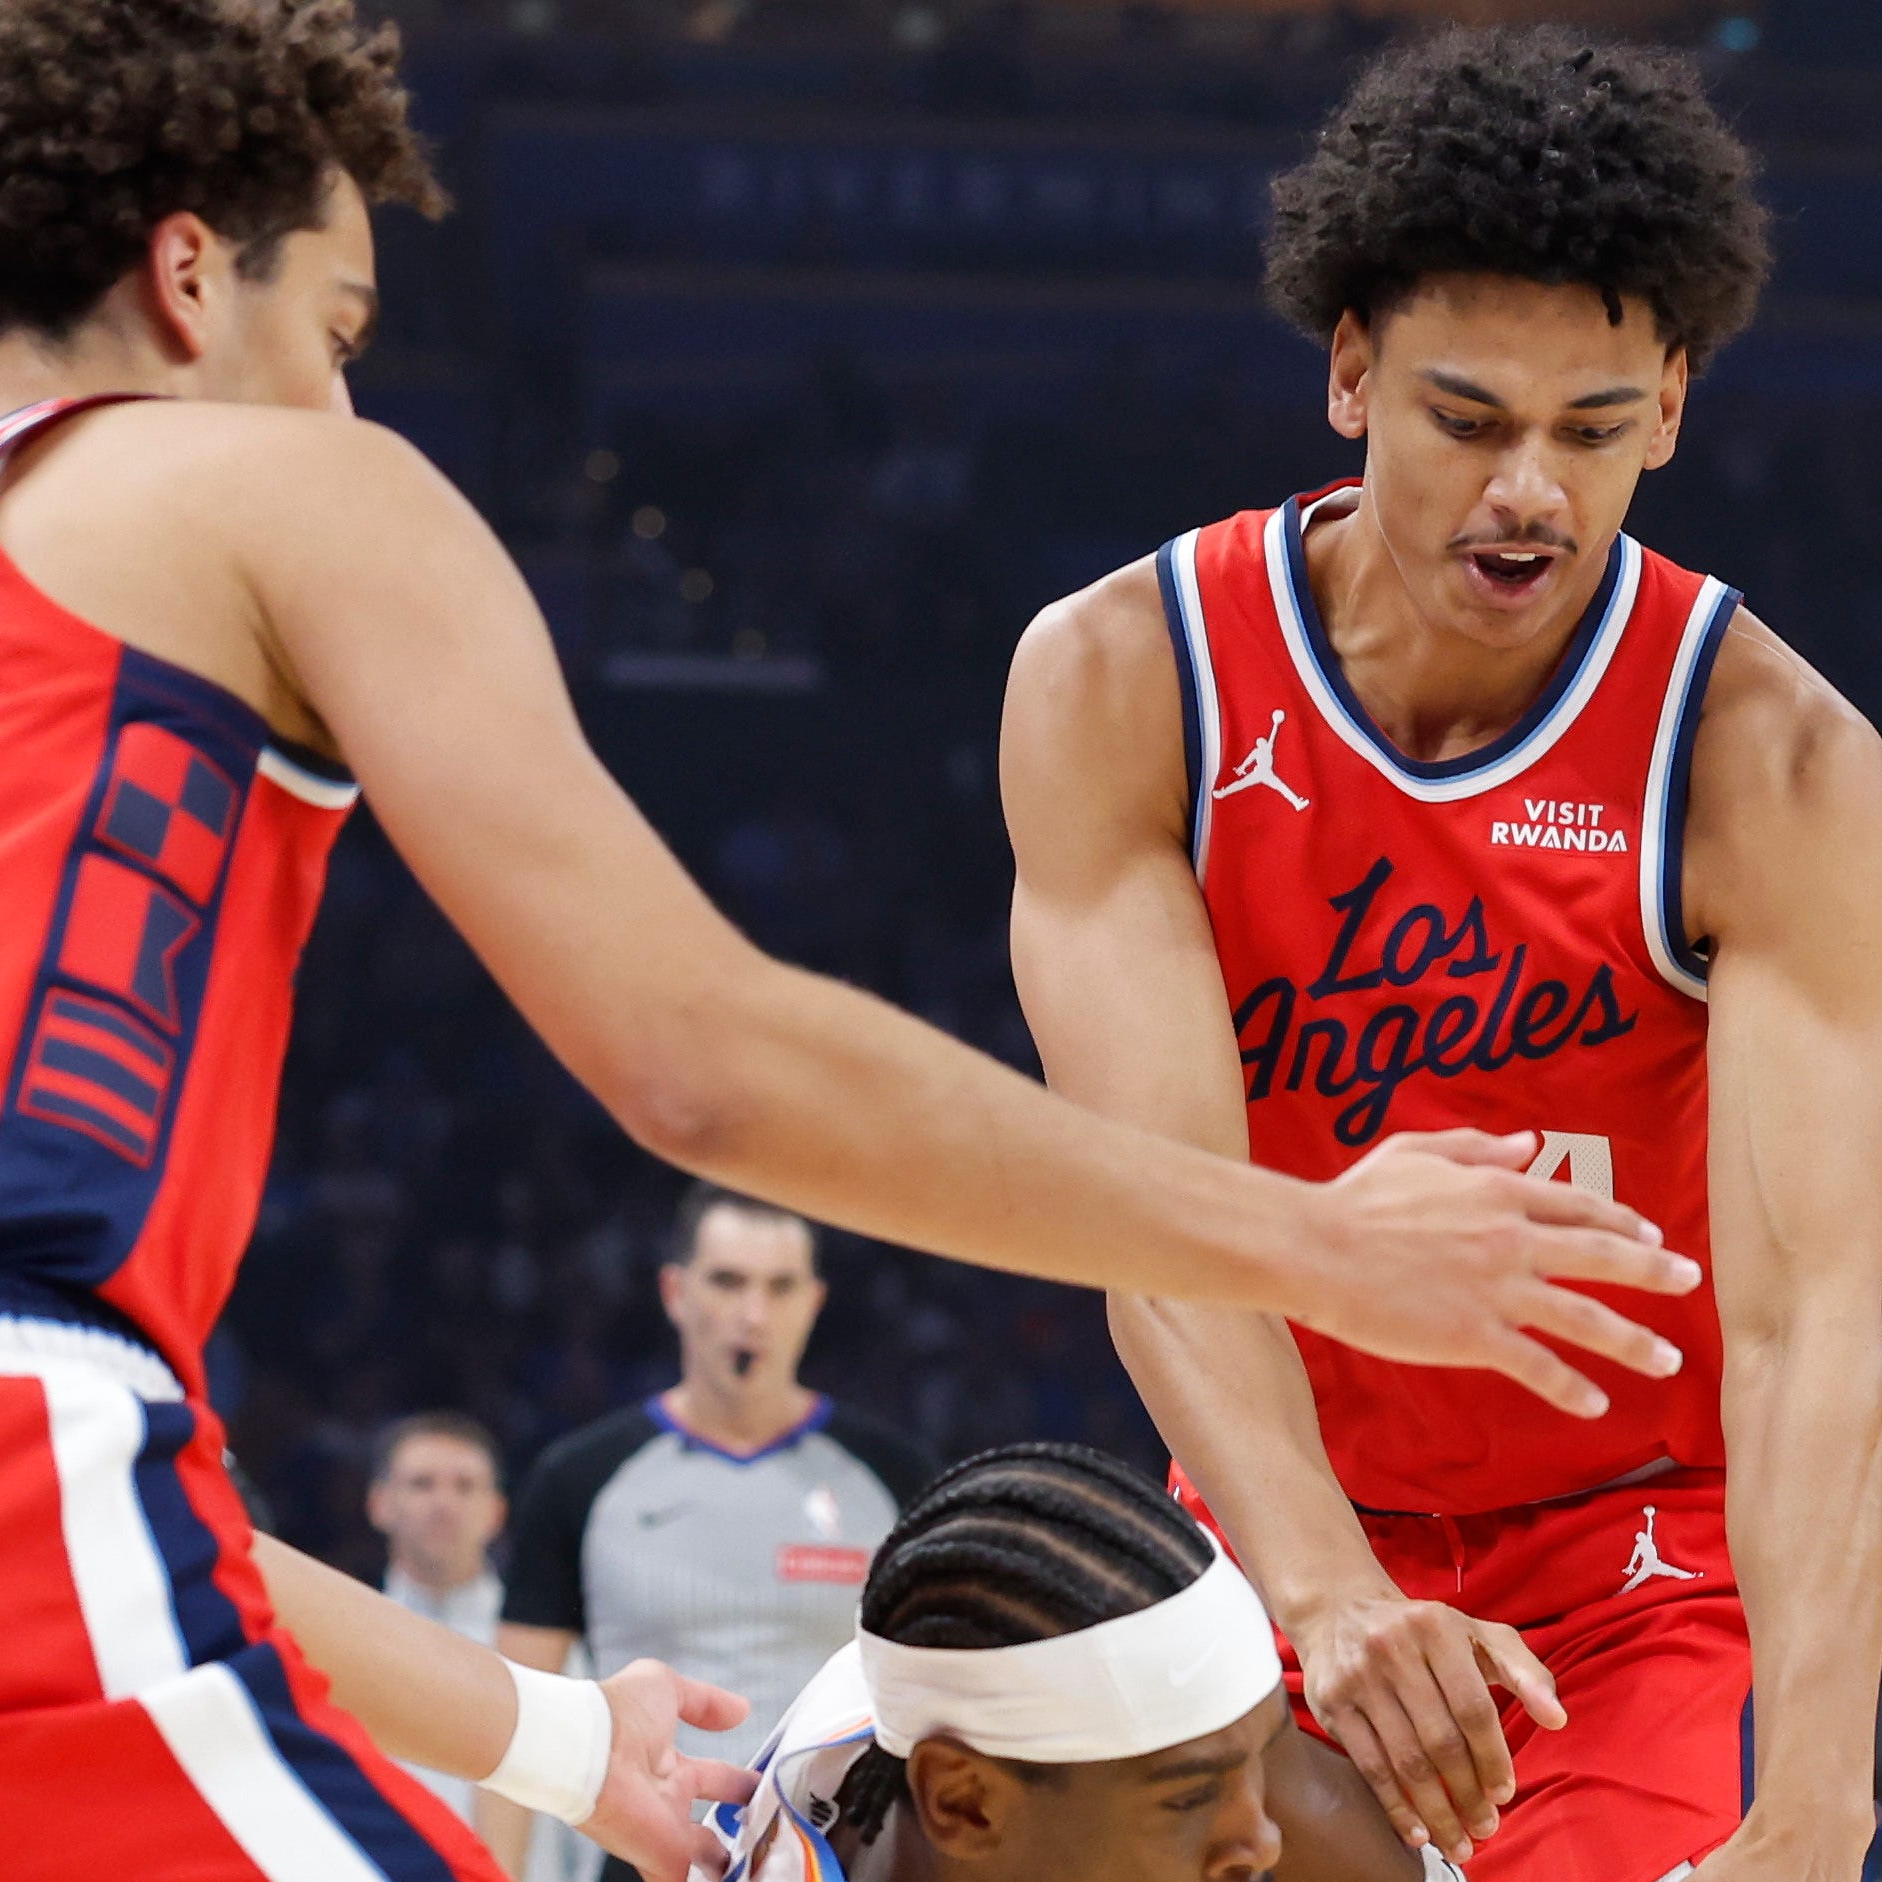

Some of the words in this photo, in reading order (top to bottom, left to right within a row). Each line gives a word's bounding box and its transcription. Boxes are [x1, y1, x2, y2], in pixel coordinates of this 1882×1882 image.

[1491, 821, 1629, 854] RWANDA
[1524, 798, 1604, 828] VISIT
[1306, 856, 1500, 1001] Los
[1233, 944, 1640, 1147] Angeles
